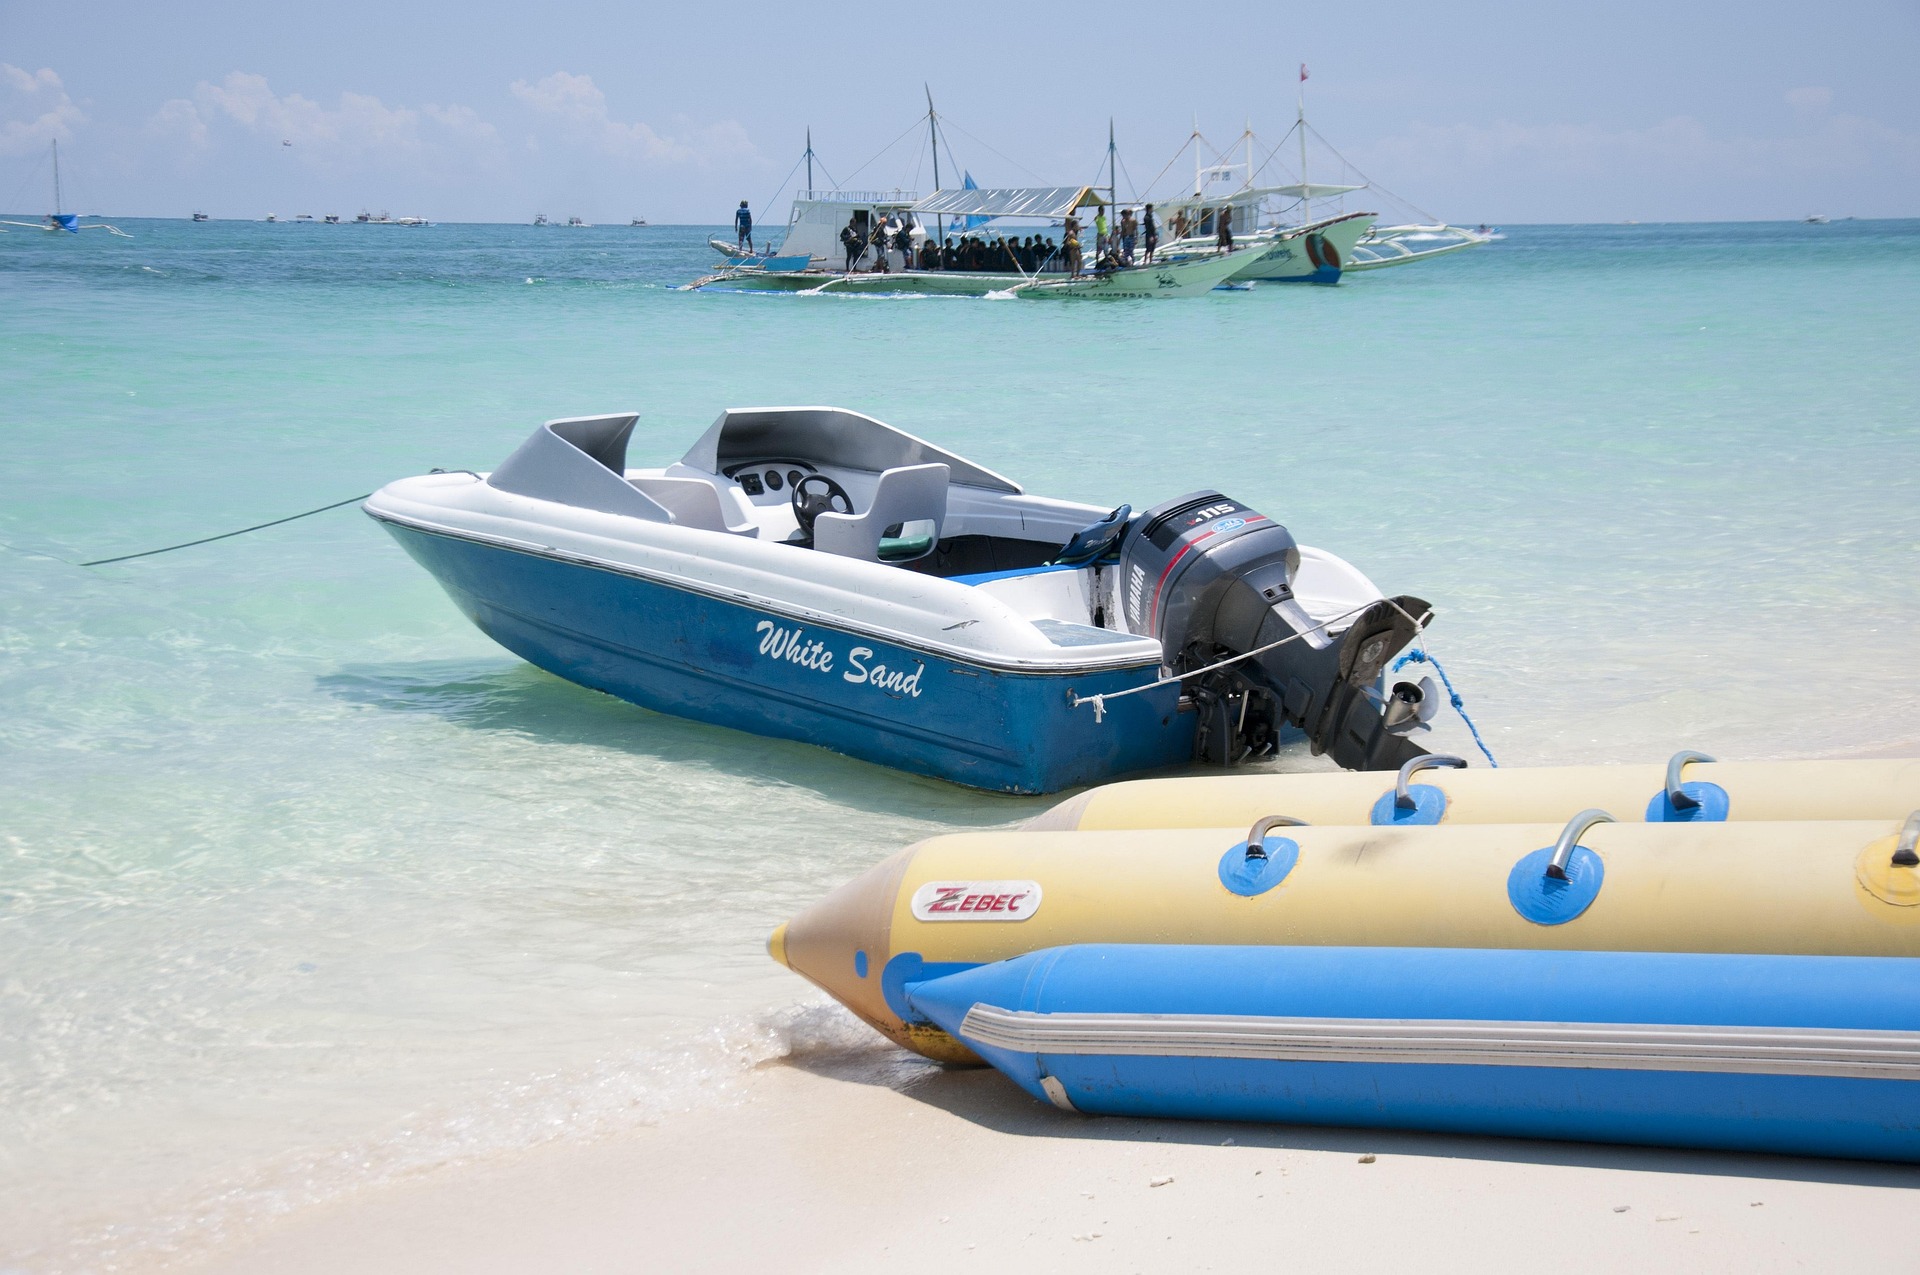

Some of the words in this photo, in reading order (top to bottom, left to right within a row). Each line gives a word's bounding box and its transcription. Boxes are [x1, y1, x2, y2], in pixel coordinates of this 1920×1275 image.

[1197, 503, 1236, 519] 115
[1129, 564, 1146, 626] YAMAHA
[756, 620, 834, 672] White
[843, 646, 925, 698] Sand
[924, 887, 1027, 914] ZEBEC
